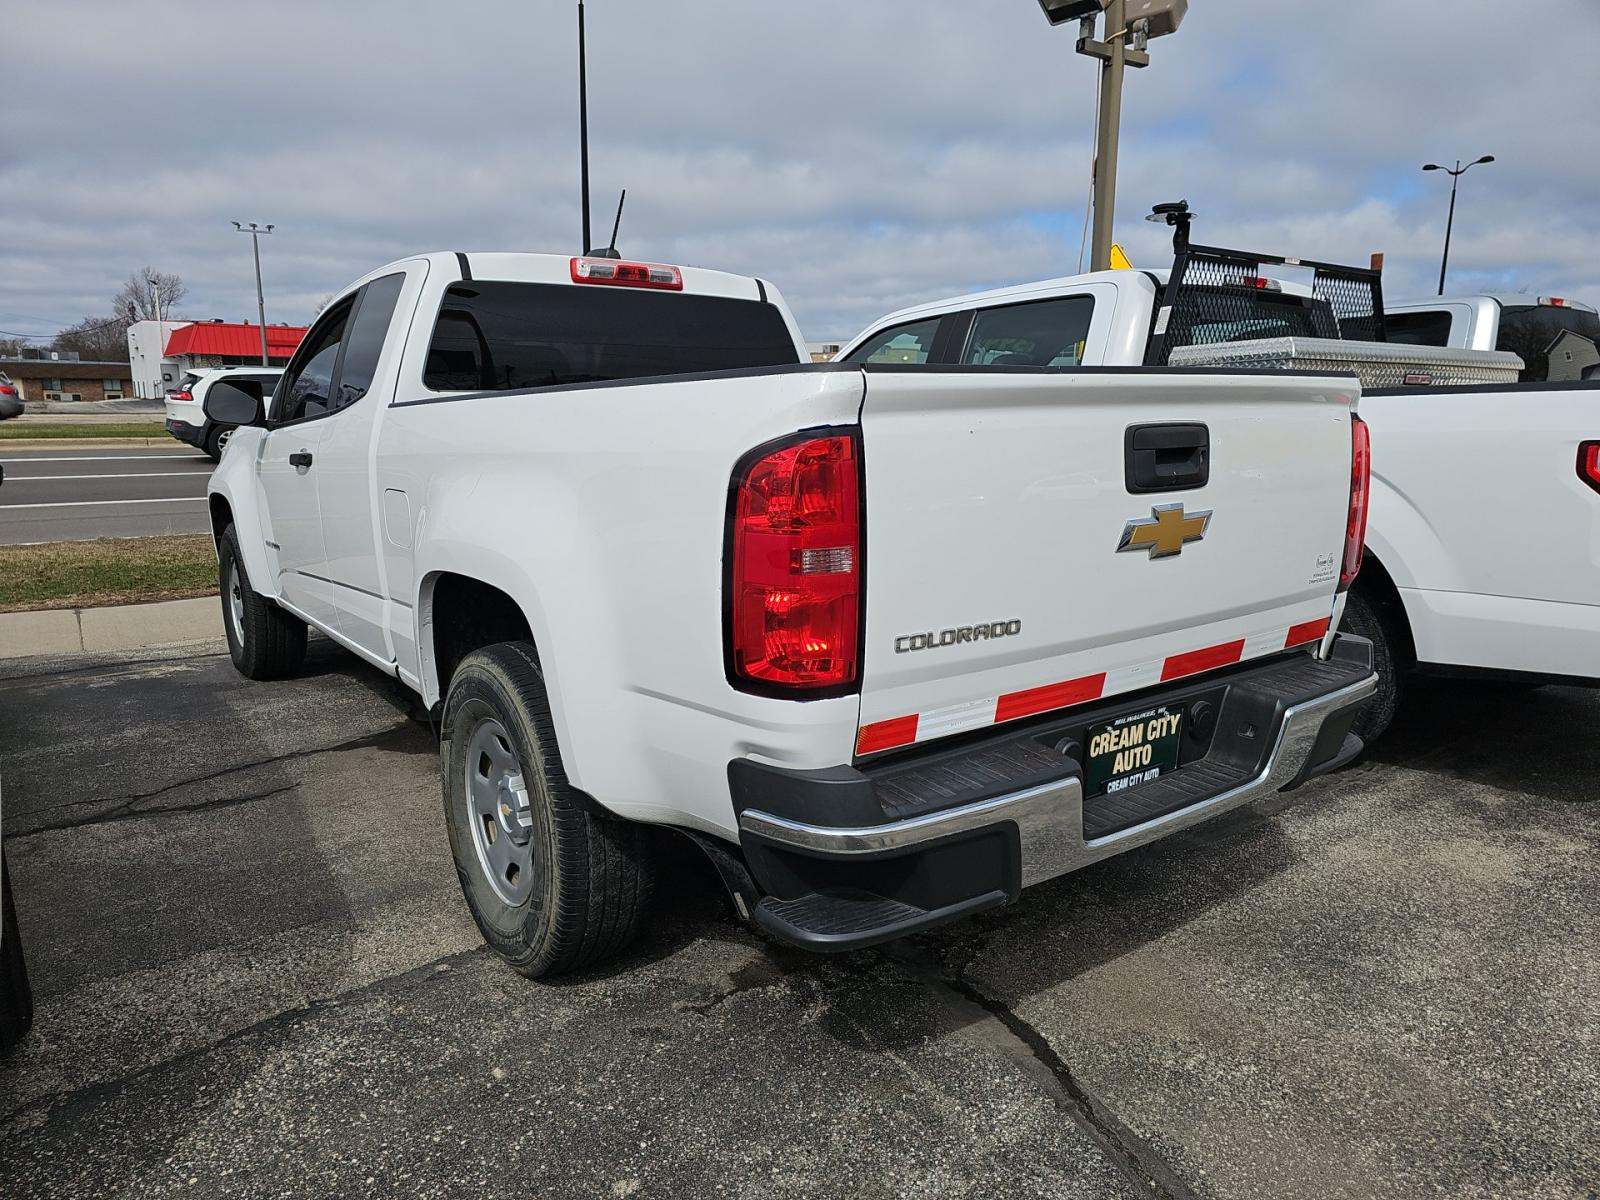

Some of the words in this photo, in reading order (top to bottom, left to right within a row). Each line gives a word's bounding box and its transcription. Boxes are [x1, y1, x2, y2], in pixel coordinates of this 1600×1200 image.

[895, 619, 1021, 654] COLORADO
[1090, 723, 1144, 758] CREAM
[1146, 714, 1181, 741] CITY
[1112, 744, 1152, 775] AUTO
[1107, 780, 1129, 794] CREAM
[1129, 773, 1144, 787] CITY
[1143, 768, 1160, 782] AUTO
